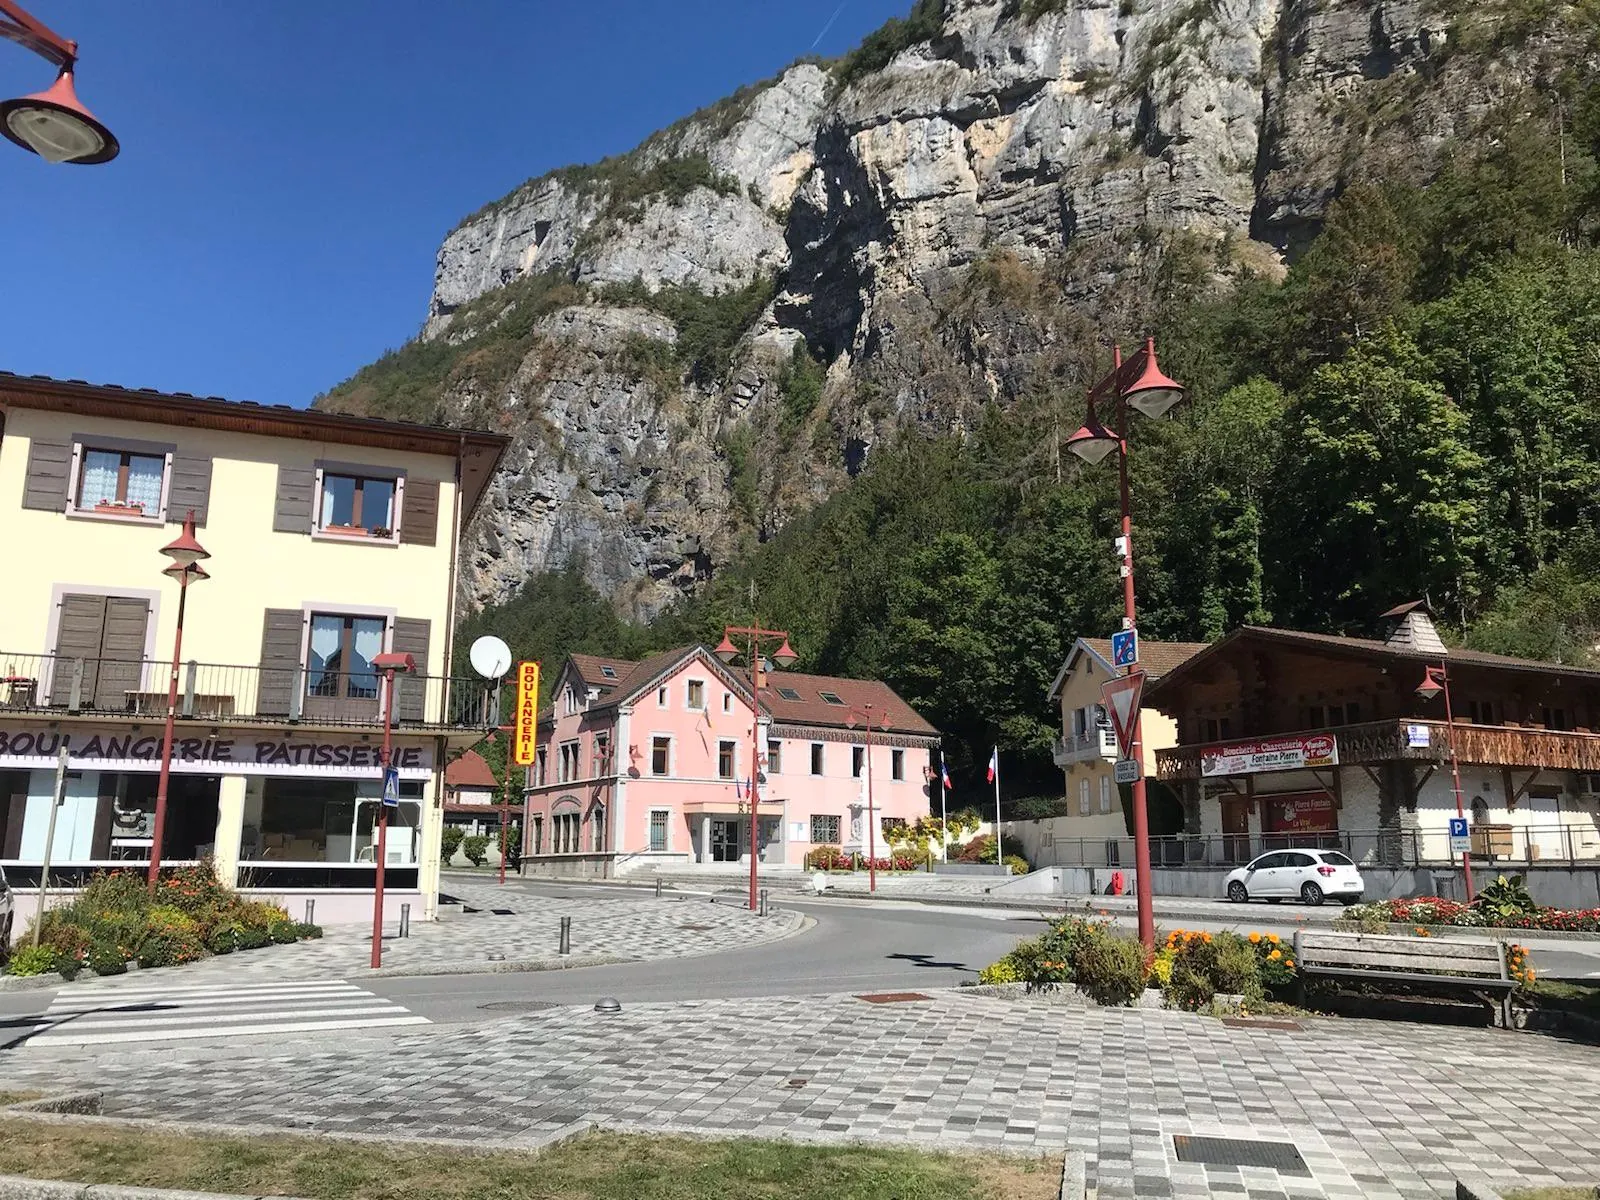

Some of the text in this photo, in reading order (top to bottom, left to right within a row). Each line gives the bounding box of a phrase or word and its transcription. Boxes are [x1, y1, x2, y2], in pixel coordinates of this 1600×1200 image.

[521, 666, 534, 760] BOULANGERIE
[1223, 745, 1257, 757] Boucherie
[1260, 740, 1303, 752] Charcuterie
[1252, 752, 1279, 764] Fontaine
[1279, 751, 1299, 761] Pierre
[1454, 821, 1463, 834] P
